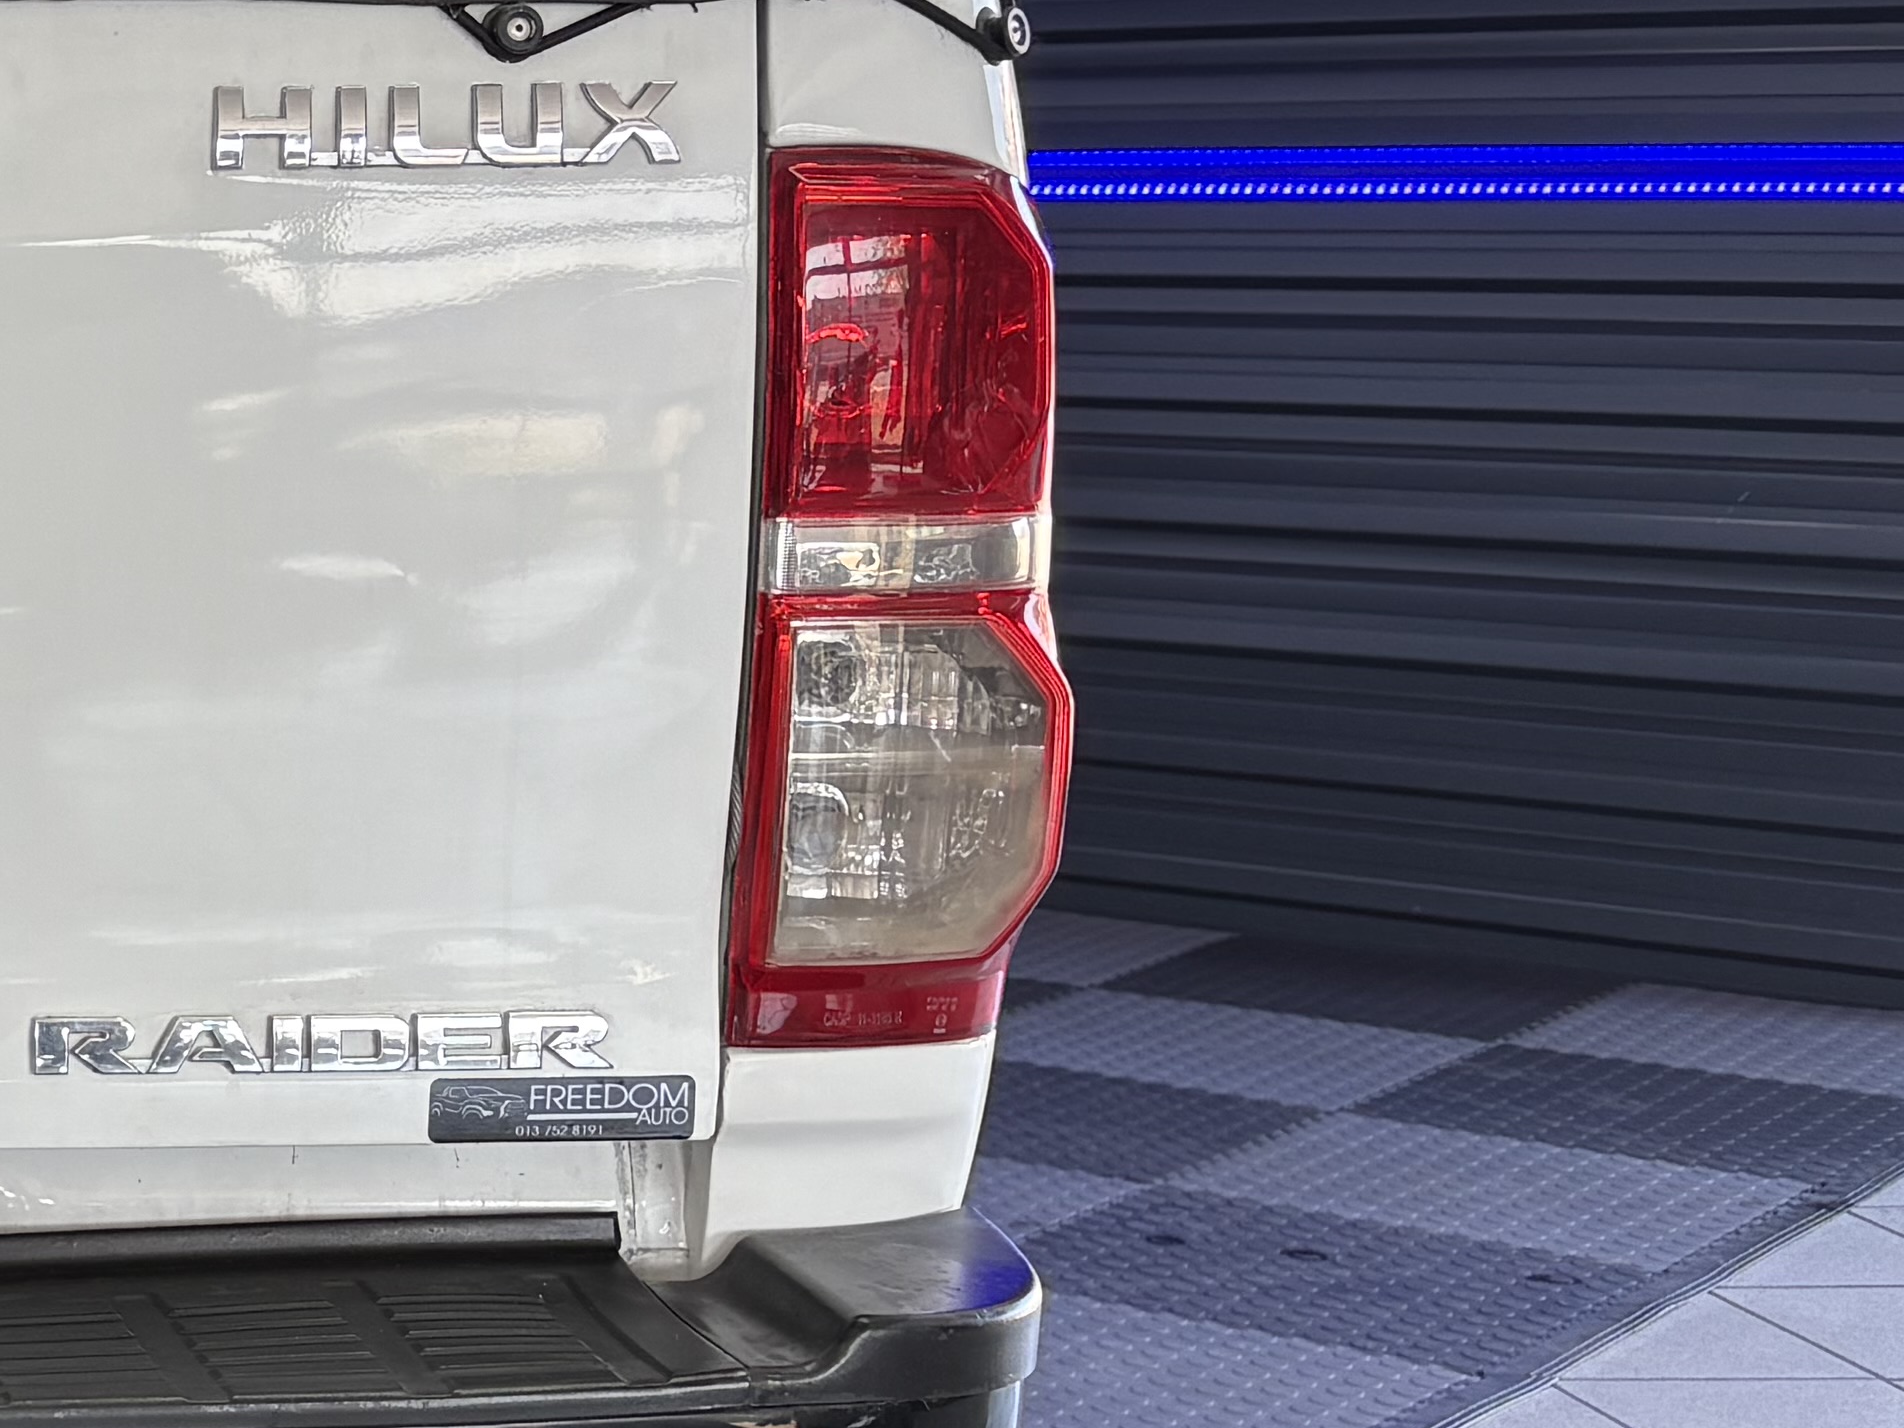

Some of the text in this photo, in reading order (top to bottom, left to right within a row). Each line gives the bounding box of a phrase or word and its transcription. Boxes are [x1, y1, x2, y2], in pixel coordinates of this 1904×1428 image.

[212, 81, 681, 169] HILUX
[33, 1011, 614, 1074] RAIDER
[529, 1082, 689, 1110] FREEDOM
[515, 1125, 540, 1137] 013
[572, 1123, 603, 1136] 8191
[635, 1107, 688, 1125] AUTO
